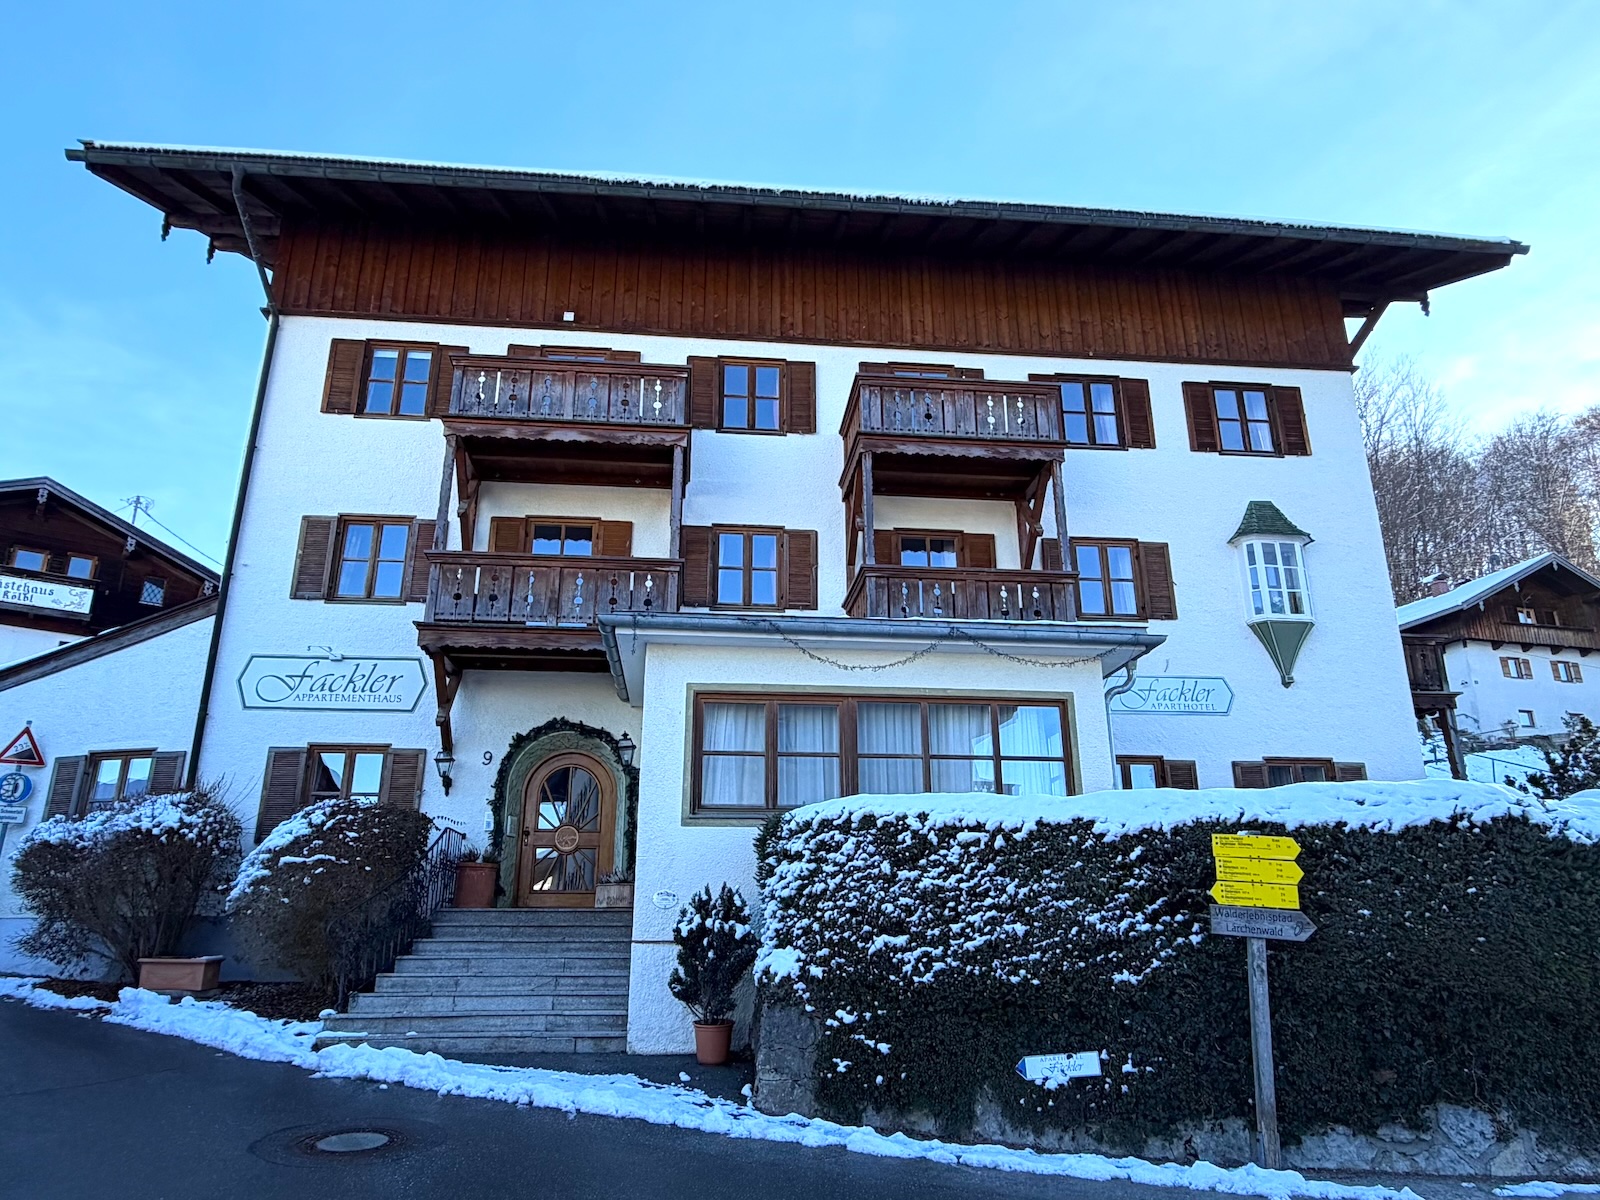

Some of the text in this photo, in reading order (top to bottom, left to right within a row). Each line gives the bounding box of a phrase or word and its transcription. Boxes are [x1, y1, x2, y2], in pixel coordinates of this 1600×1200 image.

[0, 580, 54, 596] stehaus
[256, 661, 403, 702] Fackler
[293, 693, 402, 703] APPARTEMENTHAUS
[1120, 679, 1215, 709] Fackler
[1150, 702, 1217, 711] APARTHOTEL
[13, 742, 30, 752] 23%
[482, 751, 493, 765] 9
[1215, 907, 1293, 923] Walderlebnispfad
[1040, 1054, 1083, 1062] APARTHEL
